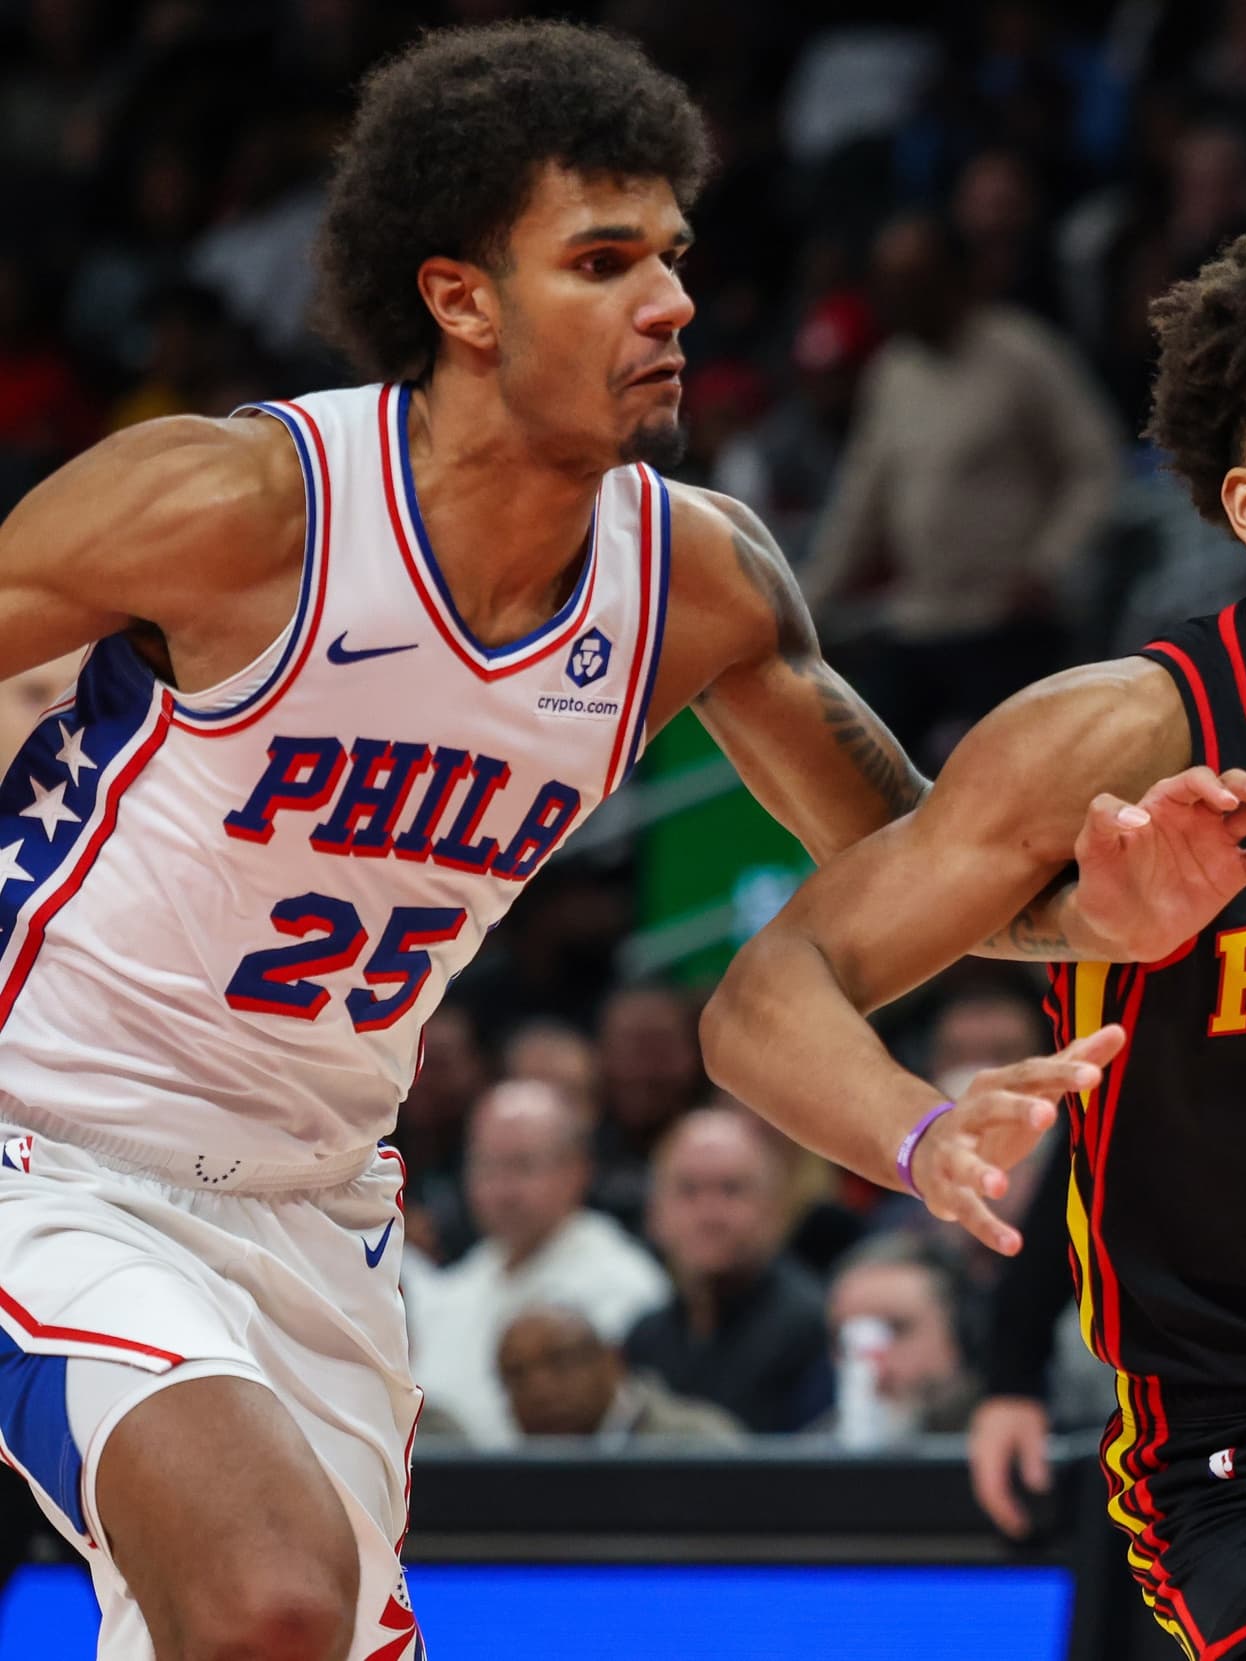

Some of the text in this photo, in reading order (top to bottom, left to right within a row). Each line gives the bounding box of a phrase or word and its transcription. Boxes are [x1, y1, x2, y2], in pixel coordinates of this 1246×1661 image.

[537, 696, 618, 715] crypto.com
[223, 735, 581, 882] PHILA
[224, 891, 468, 1034] 25
